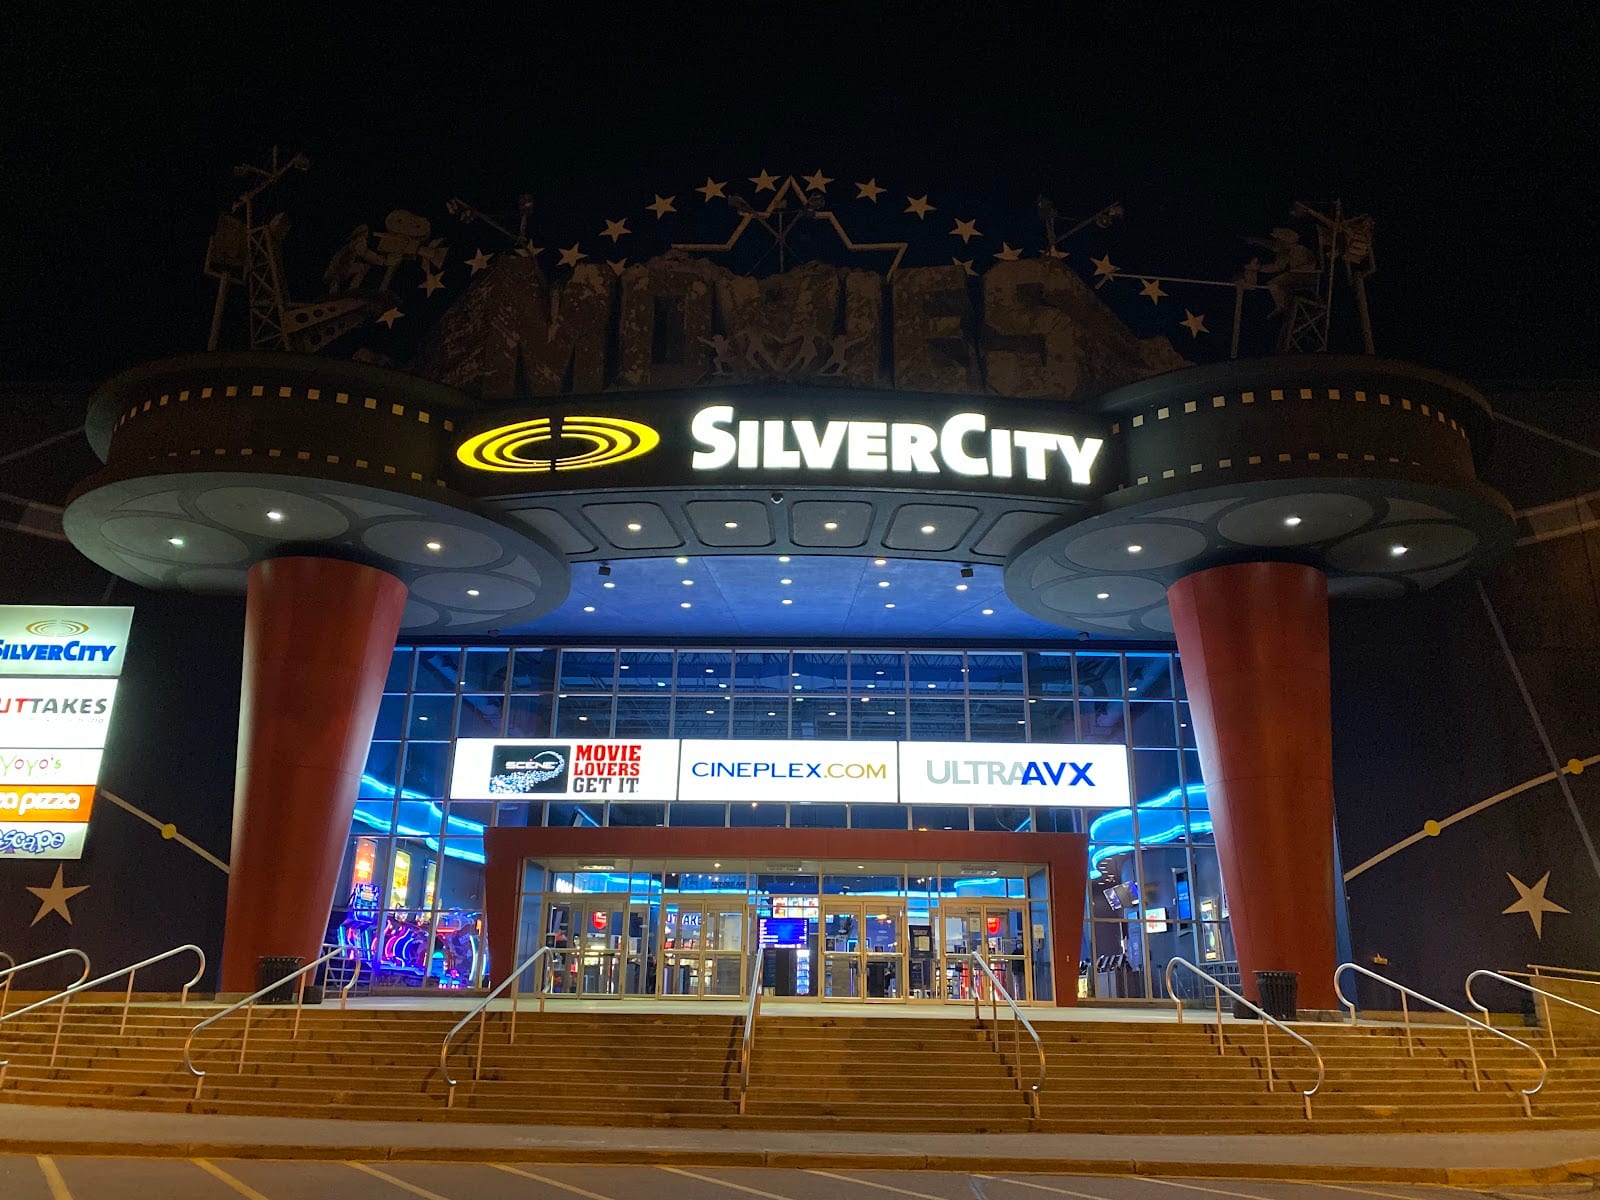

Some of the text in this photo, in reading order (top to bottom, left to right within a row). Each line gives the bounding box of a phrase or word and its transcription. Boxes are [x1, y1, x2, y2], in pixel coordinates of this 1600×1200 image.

[575, 745, 641, 761] MOVIE
[573, 762, 640, 776] LOVERS
[691, 762, 887, 779] CINEPLEX.COM
[573, 777, 611, 793] GET
[18, 792, 80, 815] pizza
